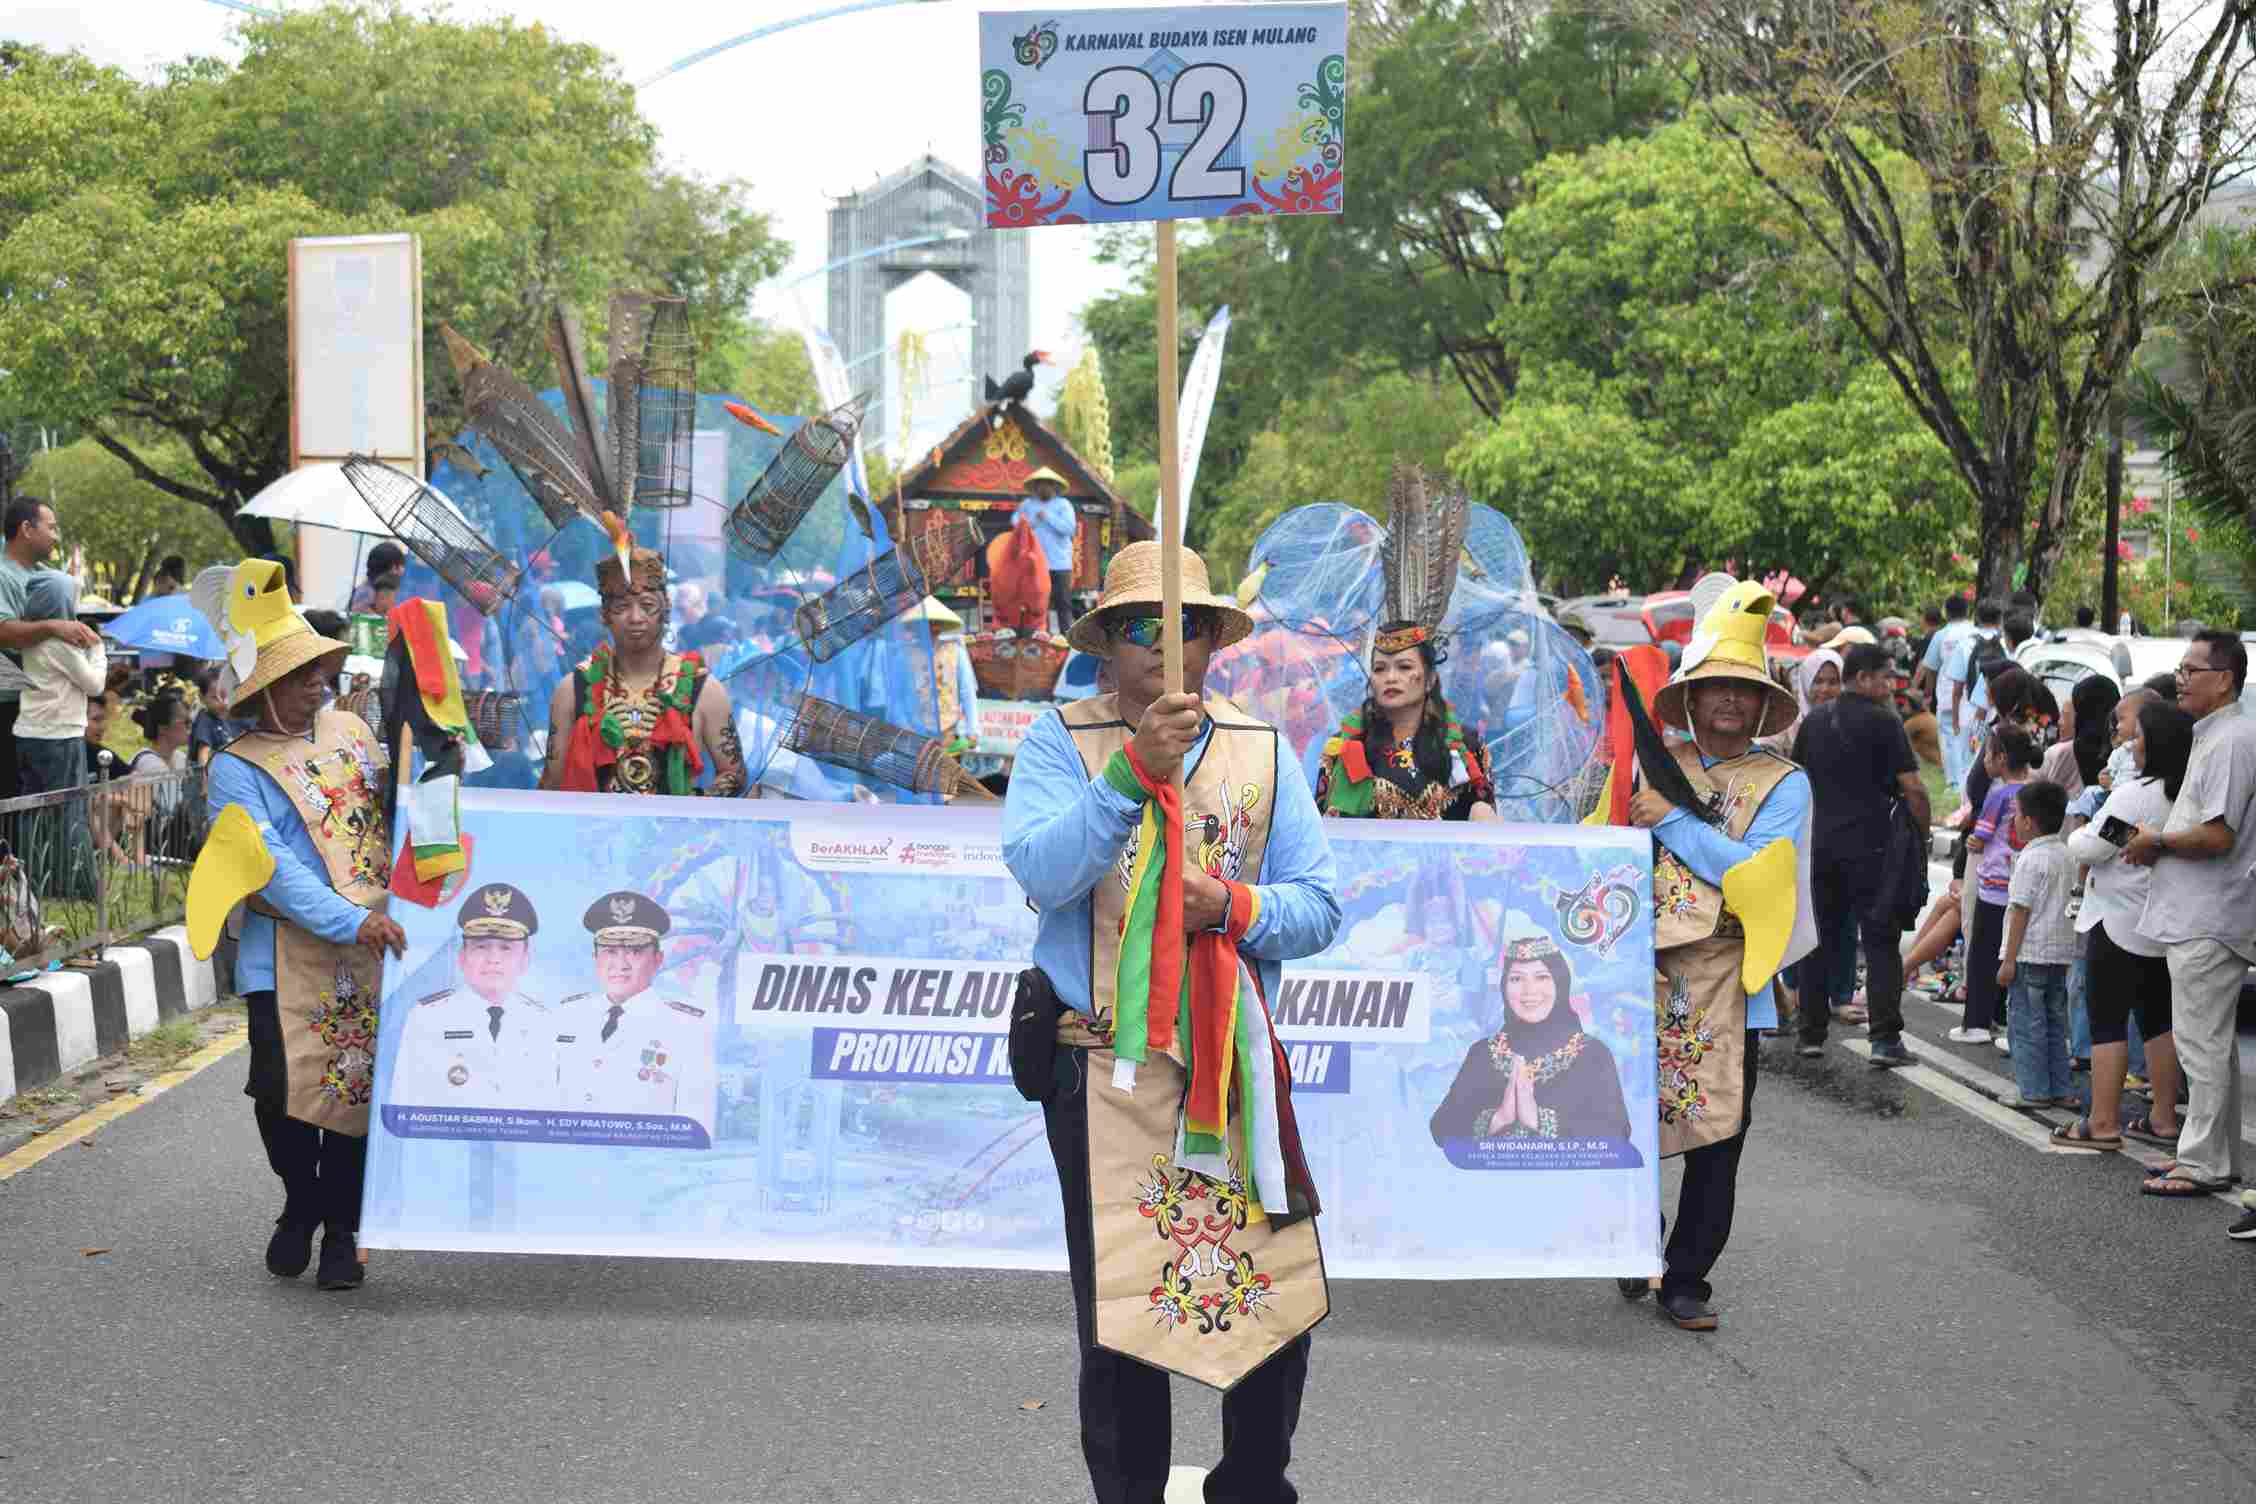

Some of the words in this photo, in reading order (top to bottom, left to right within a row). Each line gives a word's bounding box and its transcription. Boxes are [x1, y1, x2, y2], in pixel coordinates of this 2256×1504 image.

[1065, 33, 1144, 51] KARNAVAL
[1150, 31, 1208, 49] BUDAYA
[1213, 29, 1248, 46] ISEN
[1251, 27, 1318, 45] MULANG
[1083, 62, 1247, 206] 32
[751, 964, 877, 1014] DINAS
[882, 968, 1018, 1018] KELAU
[1275, 979, 1414, 1028] KANAN
[829, 1032, 984, 1075] PROVINSI
[1290, 1044, 1333, 1084] AH
